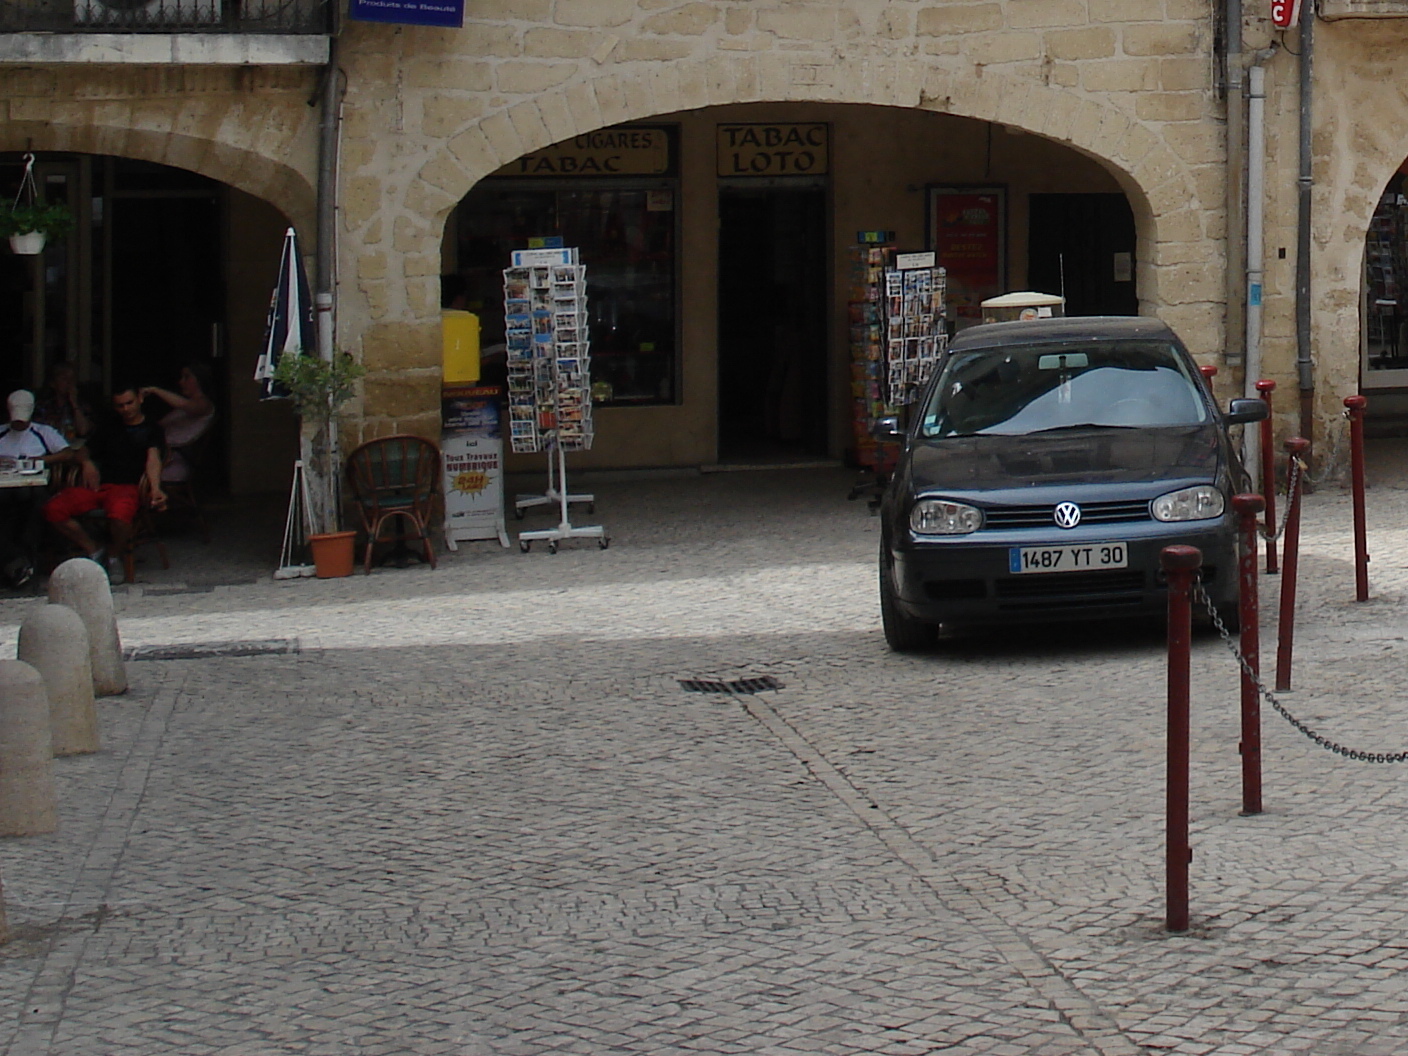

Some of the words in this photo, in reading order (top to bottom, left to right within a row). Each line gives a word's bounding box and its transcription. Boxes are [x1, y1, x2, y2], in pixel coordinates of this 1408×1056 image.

[358, 0, 401, 8] Produits
[575, 132, 653, 150] CIGARES
[722, 126, 824, 148] TABAC
[518, 155, 622, 173] TABAC
[733, 151, 815, 173] LOTO
[1022, 549, 1063, 569] 1487
[1071, 548, 1093, 566] YT
[1100, 546, 1123, 564] 30
